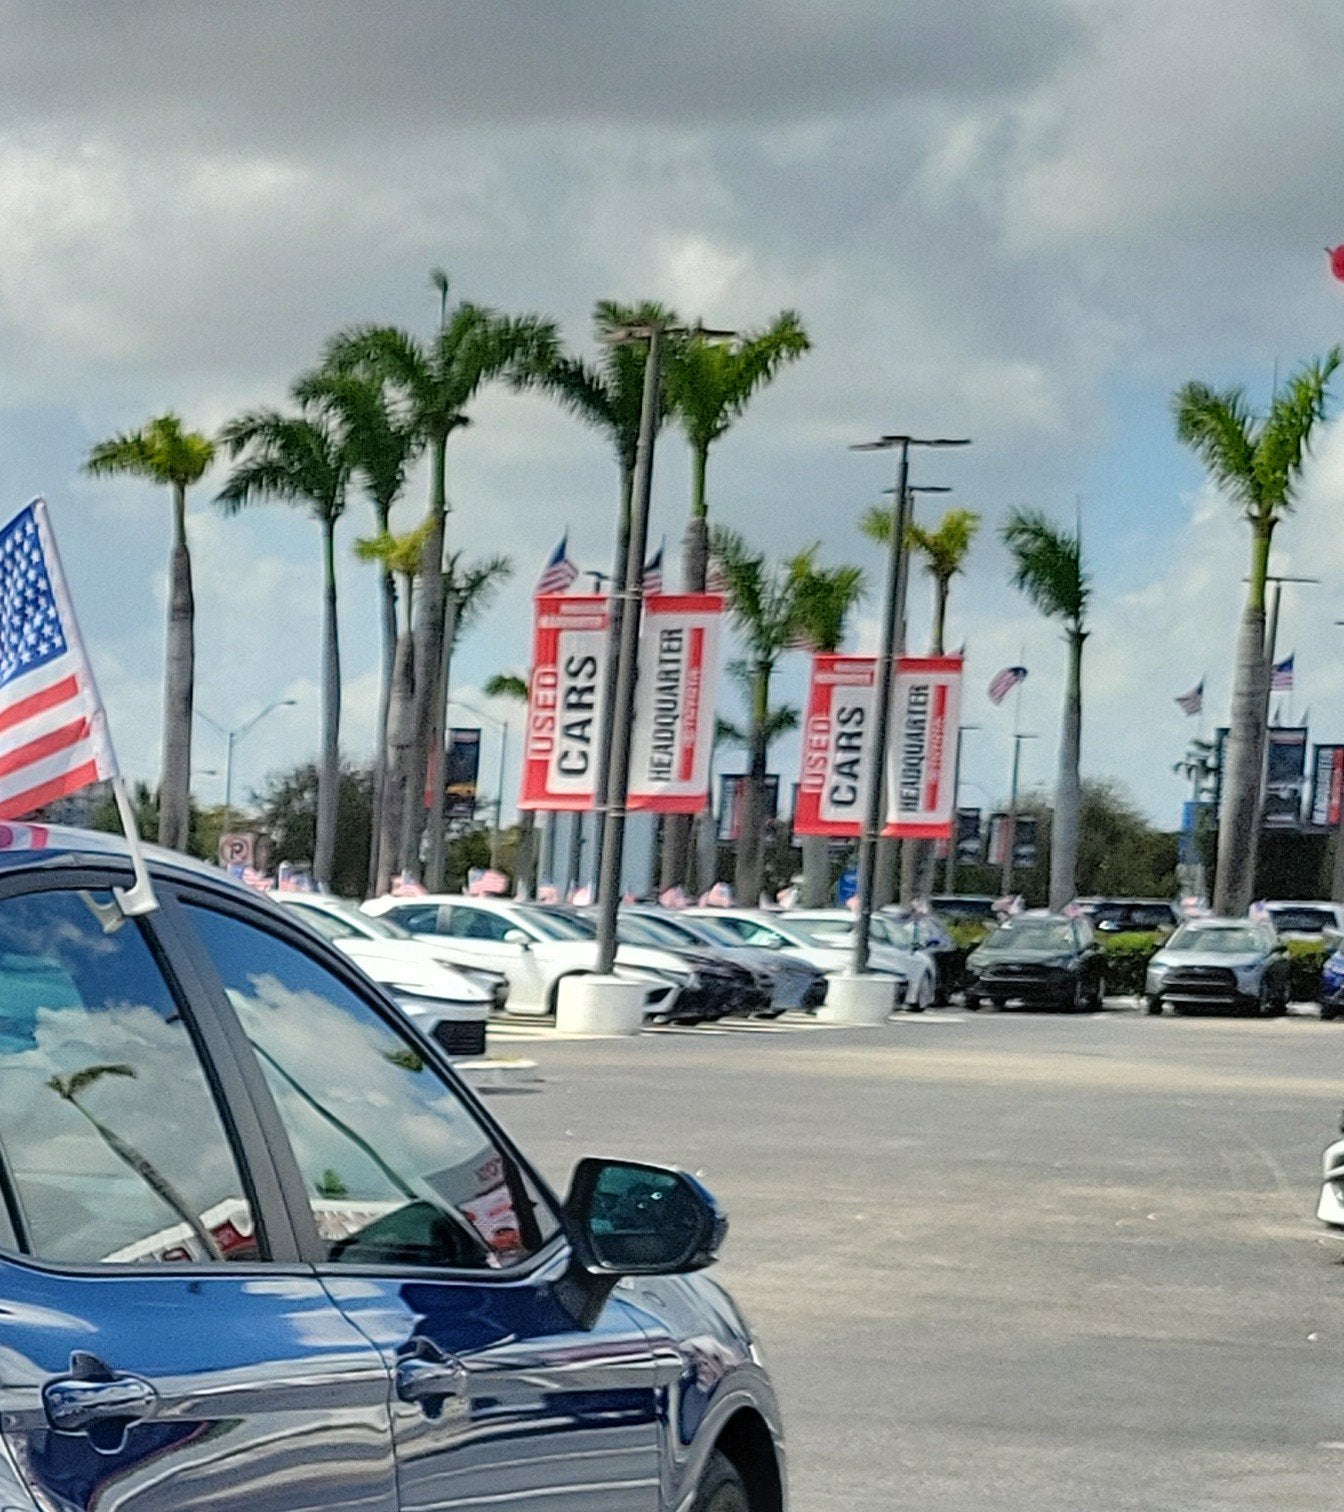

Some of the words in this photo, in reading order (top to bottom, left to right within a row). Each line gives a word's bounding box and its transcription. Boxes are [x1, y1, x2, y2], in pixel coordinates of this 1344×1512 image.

[530, 670, 557, 753] USED
[558, 655, 597, 776] CARS
[648, 627, 683, 782] HEADQUARTER
[806, 718, 830, 788] USED
[830, 706, 865, 805] CARS
[899, 684, 929, 812] HEADQUARTER
